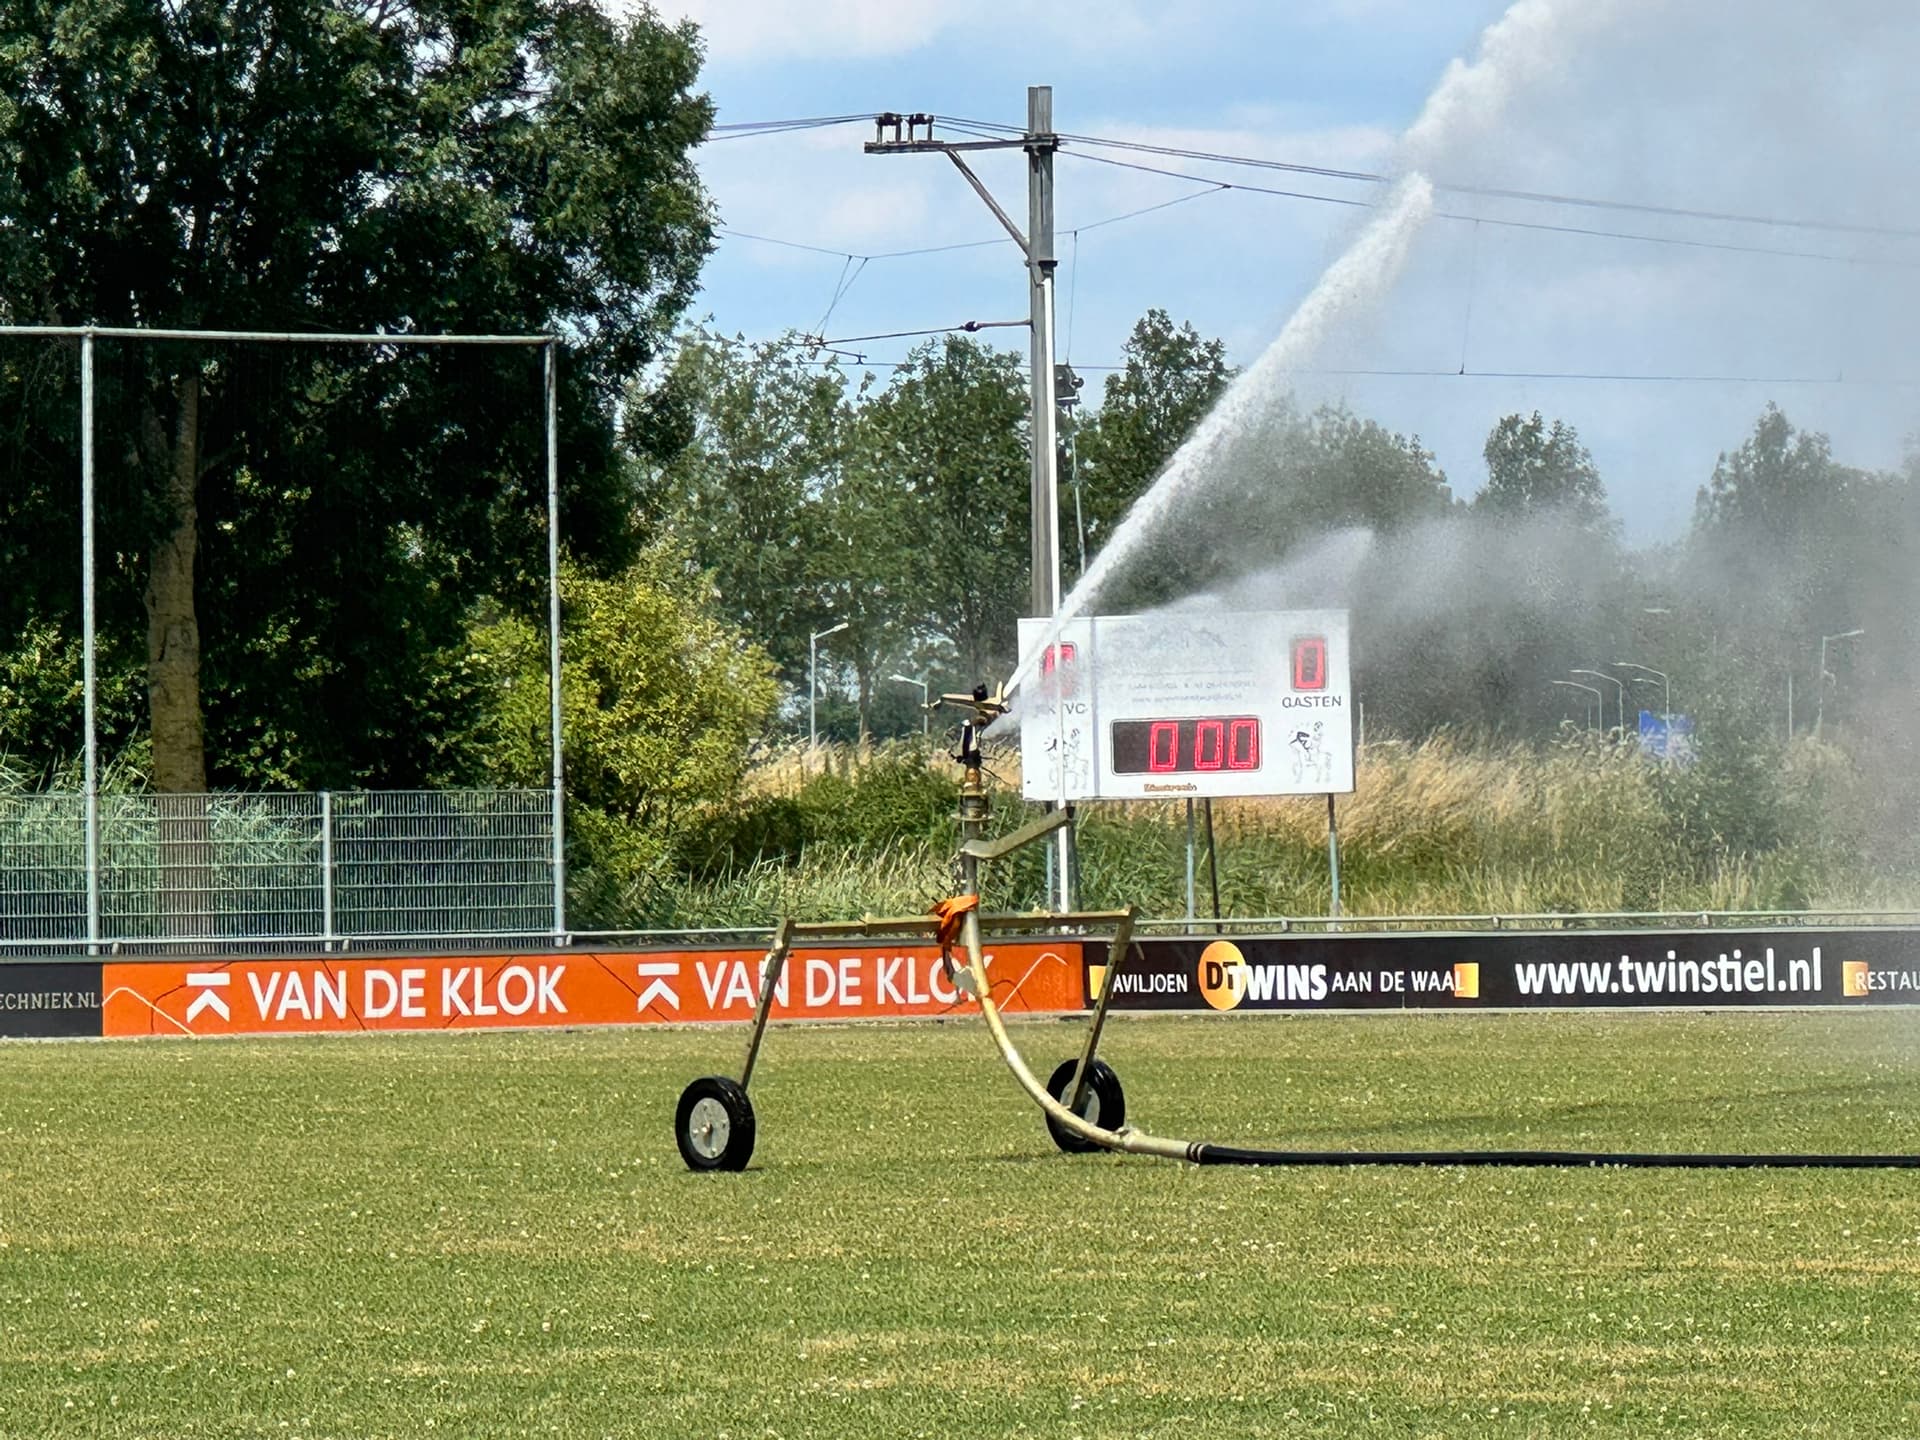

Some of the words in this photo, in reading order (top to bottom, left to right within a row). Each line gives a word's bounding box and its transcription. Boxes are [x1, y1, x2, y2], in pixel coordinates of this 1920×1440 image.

[1295, 639, 1325, 689] 0
[247, 970, 347, 1021] VAN
[364, 968, 426, 1018] DE
[442, 965, 568, 1017] KLOK
[695, 959, 789, 1010] VAN
[806, 958, 862, 1007] DE
[1112, 973, 1188, 993] AVILJOEN
[1331, 971, 1373, 993] AAN
[1380, 970, 1405, 992] DE
[1411, 969, 1465, 991] WAAL
[1514, 946, 1822, 995] www.twinstiel.nl
